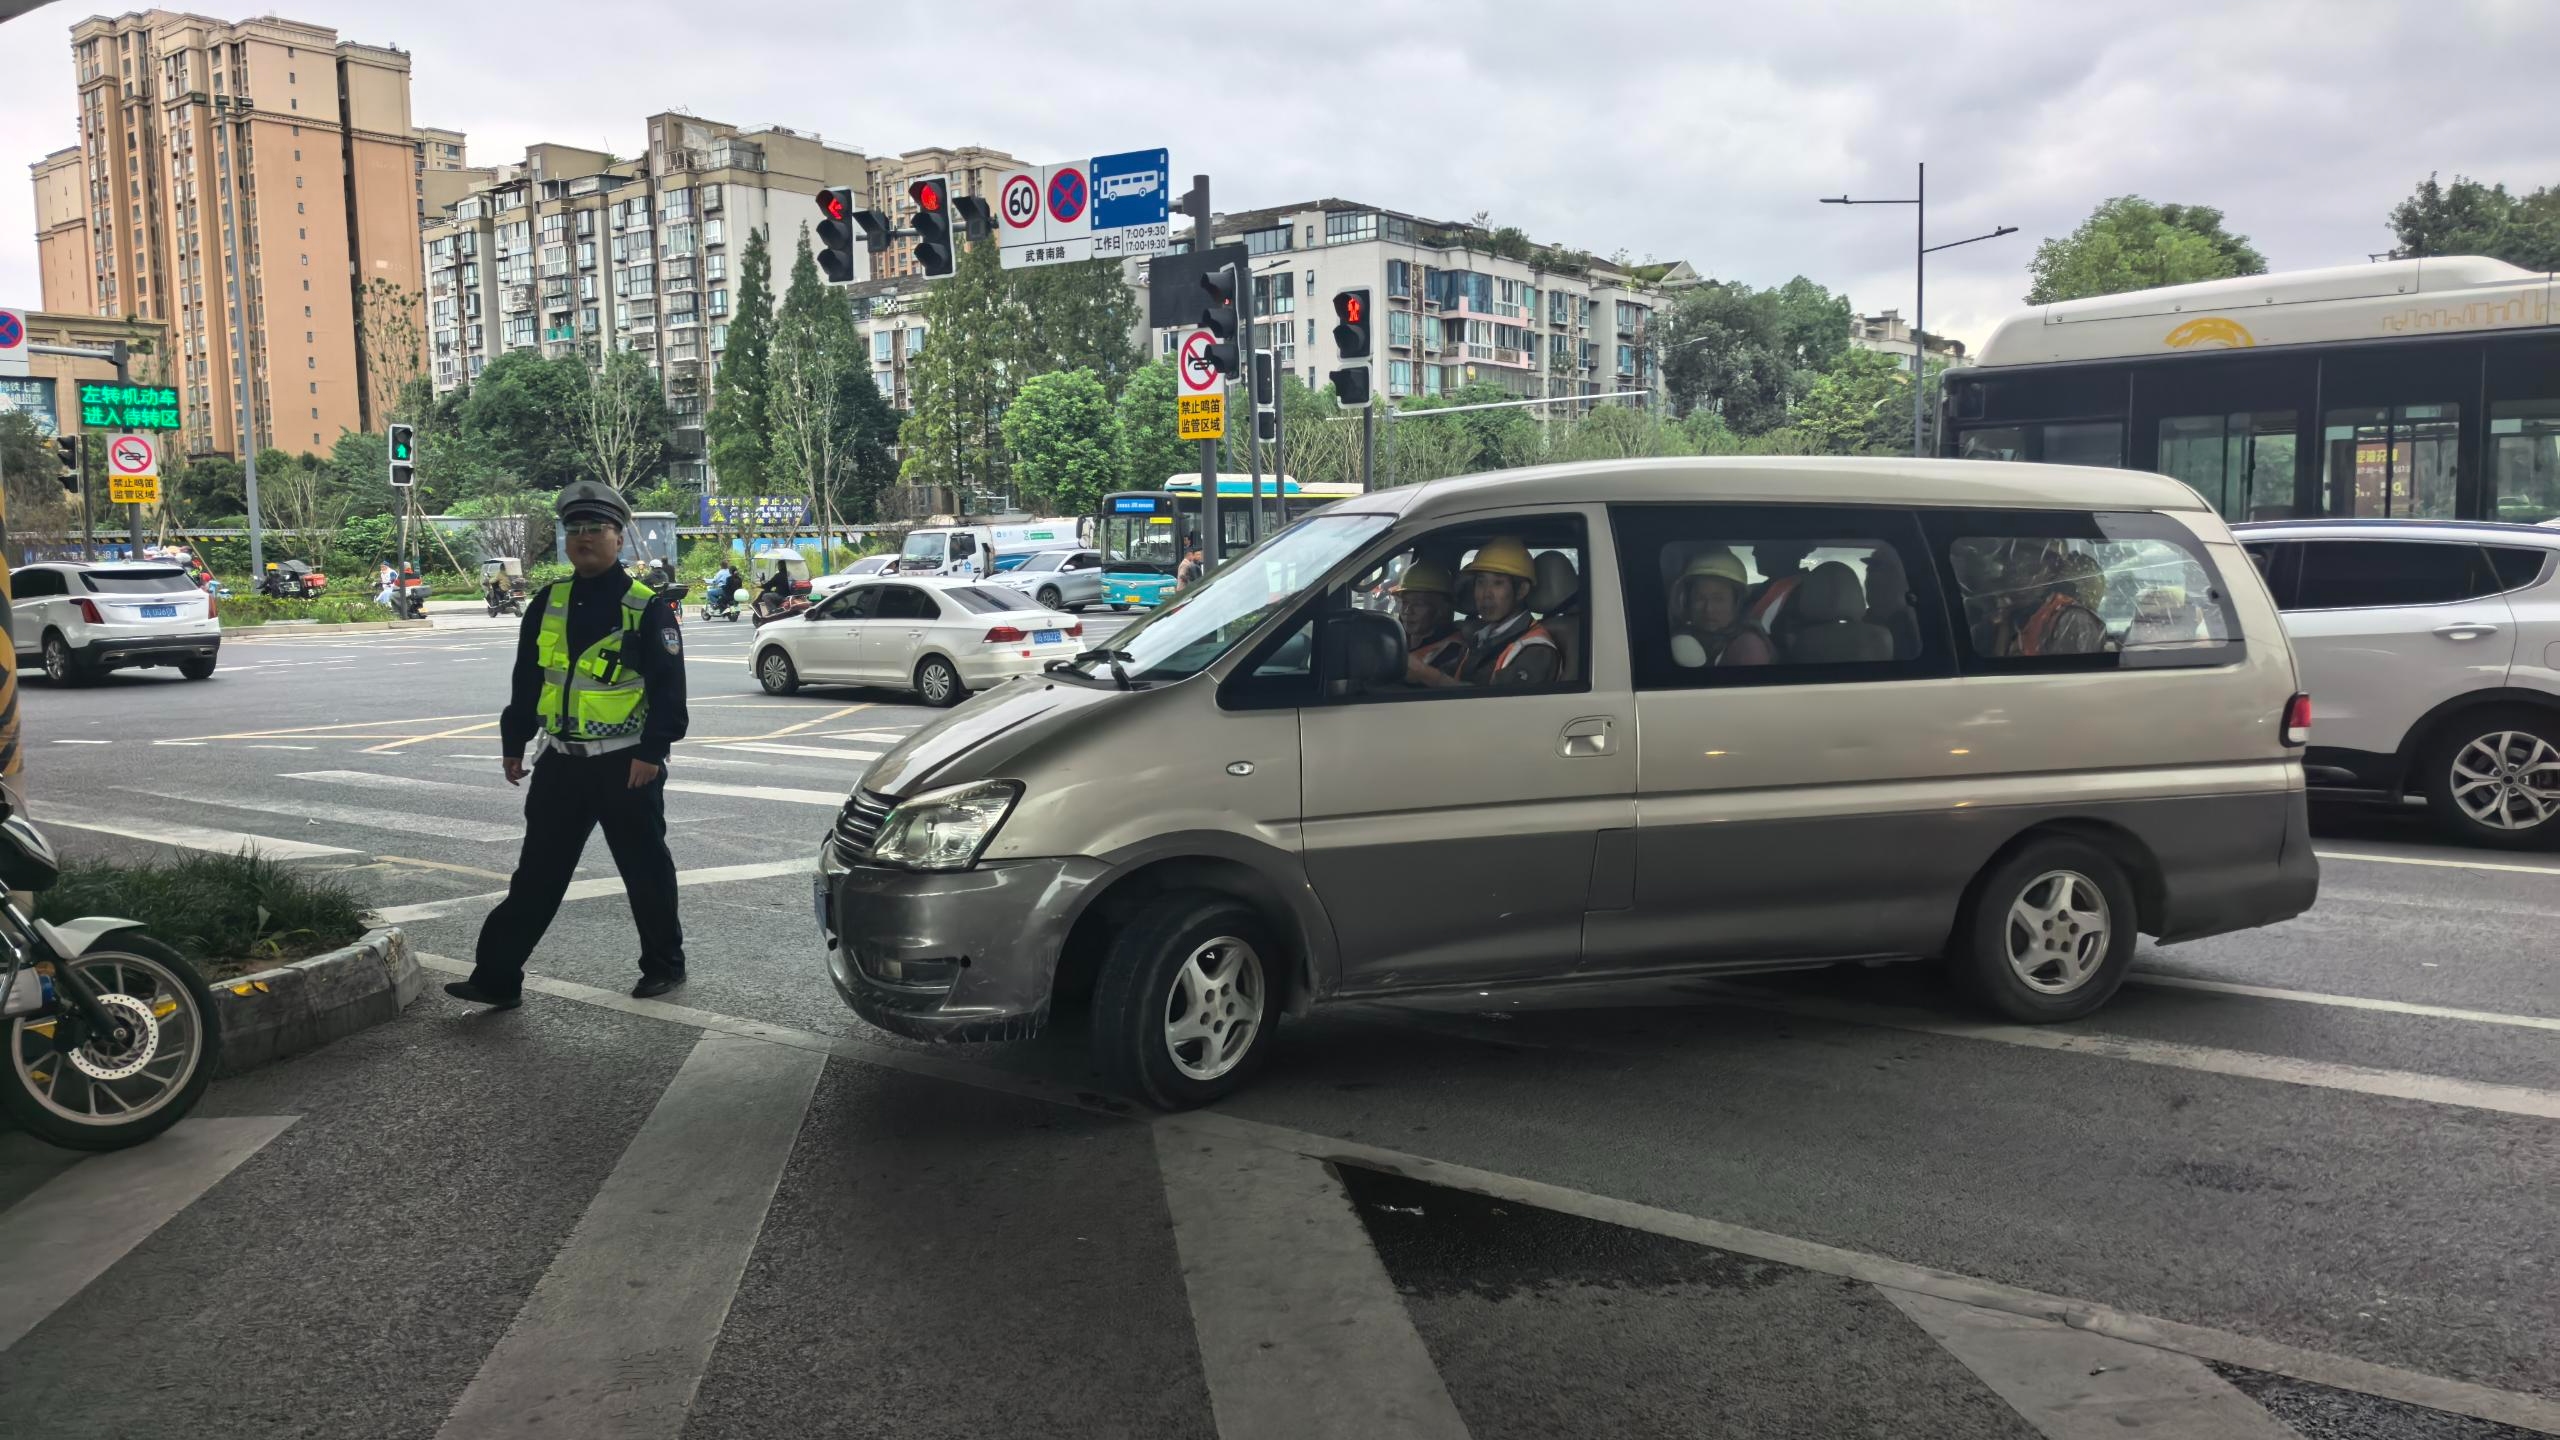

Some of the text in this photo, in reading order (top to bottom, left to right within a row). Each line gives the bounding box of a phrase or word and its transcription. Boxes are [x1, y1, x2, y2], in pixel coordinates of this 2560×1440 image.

[1009, 187, 1033, 216] 60
[1126, 225, 1166, 239] 7:00-9:30
[1094, 236, 1121, 251] 工作日
[1126, 240, 1166, 251] 17:00-19:30
[81, 384, 176, 406] 左转机动车
[1181, 399, 1221, 415] 禁止鸣笛
[83, 406, 179, 428] 进入待转区
[1181, 418, 1221, 433] 监管区域
[114, 478, 154, 488] 禁止鸣笛
[114, 490, 156, 499] 监管区域
